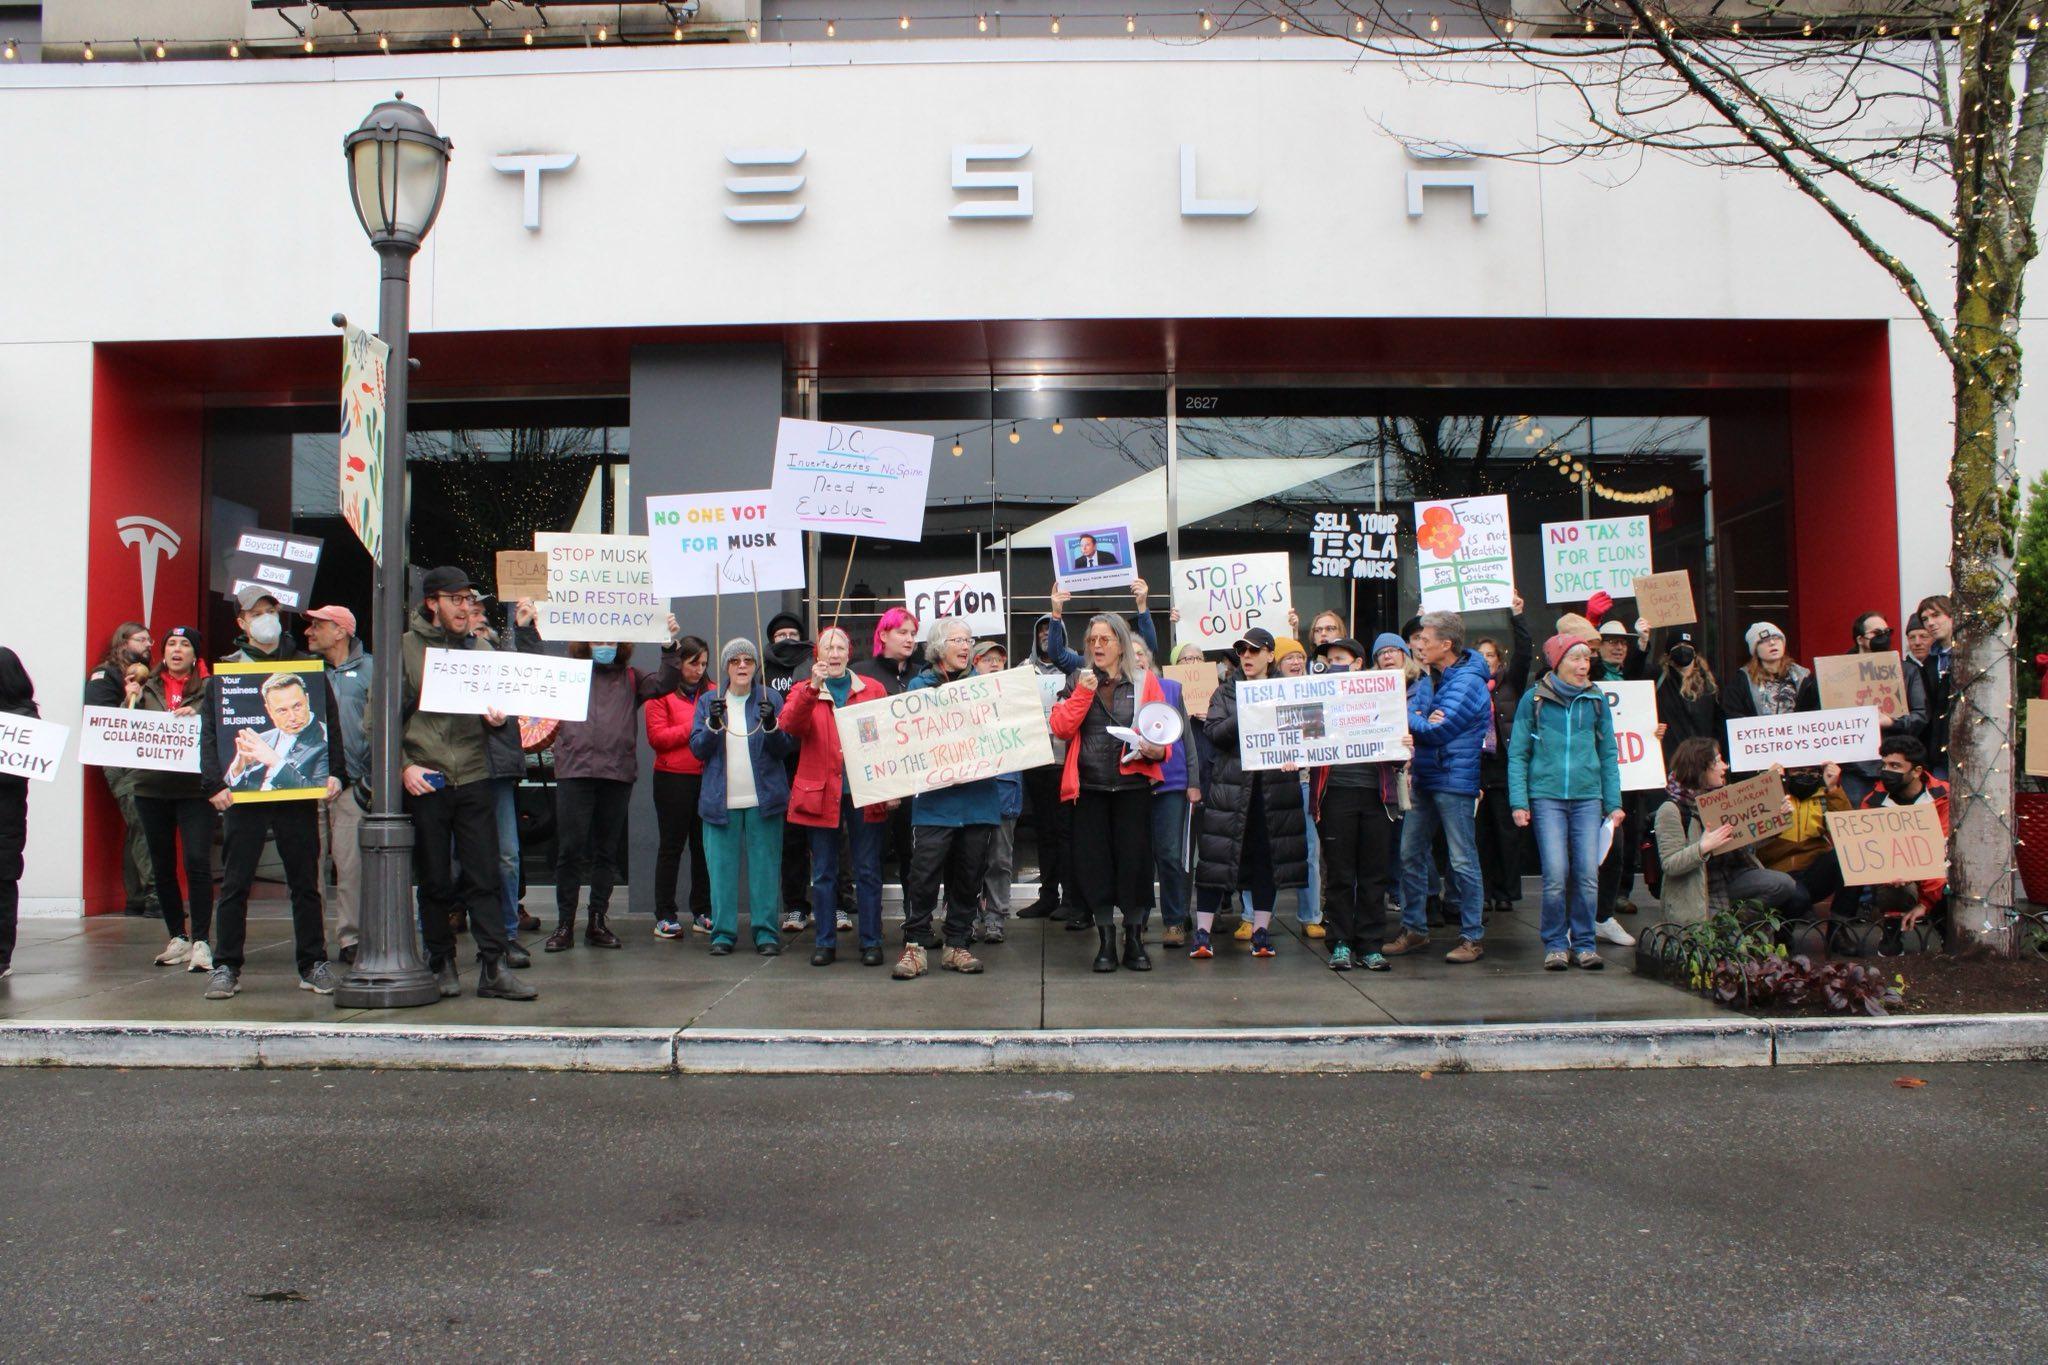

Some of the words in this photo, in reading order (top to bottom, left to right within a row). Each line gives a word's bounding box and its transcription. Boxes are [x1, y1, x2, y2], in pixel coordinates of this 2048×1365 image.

[490, 142, 1488, 230] TESLA
[1186, 397, 1218, 409] 2627
[787, 453, 870, 472] Invertebrates
[868, 483, 885, 494] to
[655, 511, 681, 525] NO
[687, 507, 725, 524] ONE
[796, 496, 873, 518] Evolve
[1450, 500, 1503, 525] Fascism
[1314, 512, 1350, 531] SELL
[1358, 513, 1398, 534] YOUR
[1468, 535, 1478, 545] is
[1487, 531, 1507, 541] not
[1550, 526, 1579, 545] NO
[1586, 523, 1620, 541] TAX
[1628, 521, 1645, 537] $$
[245, 537, 280, 552] Boycott
[290, 546, 313, 560] Tesla
[682, 537, 718, 553] FOR
[727, 533, 777, 550] MUSK
[1310, 531, 1398, 559] TESLA
[552, 548, 595, 562] STOP
[600, 549, 648, 564] MUSK
[1461, 545, 1506, 560] Healthy
[1558, 549, 1589, 566] FOR
[263, 568, 286, 581] Save
[1186, 562, 1247, 590] STOP
[1311, 557, 1350, 577] STOP
[1353, 559, 1396, 579] MUSK
[1460, 564, 1503, 575] Children
[1466, 572, 1496, 581] other
[570, 570, 611, 583] SAVE
[617, 571, 653, 585] LIVE
[1554, 569, 1604, 593] SPACE
[1209, 581, 1283, 611] MUSK'S
[1464, 586, 1489, 597] living
[1470, 595, 1500, 605] things
[550, 611, 655, 626] DEMOCRACY
[1200, 609, 1261, 636] COUP
[433, 662, 491, 676] FASCISM
[498, 665, 509, 677] IS
[514, 667, 541, 678] NOT
[545, 670, 553, 679] A
[222, 676, 241, 684] Your
[483, 682, 490, 691] A
[497, 682, 557, 698] FEATURE
[1243, 685, 1286, 704] TESLA
[1294, 680, 1336, 699] FUNDS
[1341, 676, 1396, 695] FASCISM
[222, 707, 235, 715] his
[90, 717, 128, 729] HITLER
[130, 720, 154, 731] WAS
[156, 722, 184, 735] ALSO
[894, 711, 965, 745] STAND
[969, 702, 1001, 725] UP!
[1339, 715, 1370, 726] SLASHING
[1737, 725, 1793, 740] EXTREME
[1797, 718, 1870, 734] INEQUALITY
[103, 731, 194, 747] COLLABORATORS
[1246, 734, 1275, 749] STOP
[1279, 731, 1300, 745] THE
[1745, 739, 1809, 754] DESTROYS
[1813, 734, 1865, 749] SOCIETY
[136, 747, 183, 760] GUILTY!
[1307, 747, 1339, 762] MUSK
[1346, 742, 1385, 758] COUP!!
[864, 760, 897, 782] END
[901, 752, 928, 775] THE
[1699, 790, 1728, 808] DOWN
[1720, 802, 1771, 827] POWER
[1834, 810, 1930, 837] RESTORE
[1747, 811, 1793, 838] PEOPLE
[1843, 840, 1885, 873] US
[1892, 835, 1933, 868] AID
